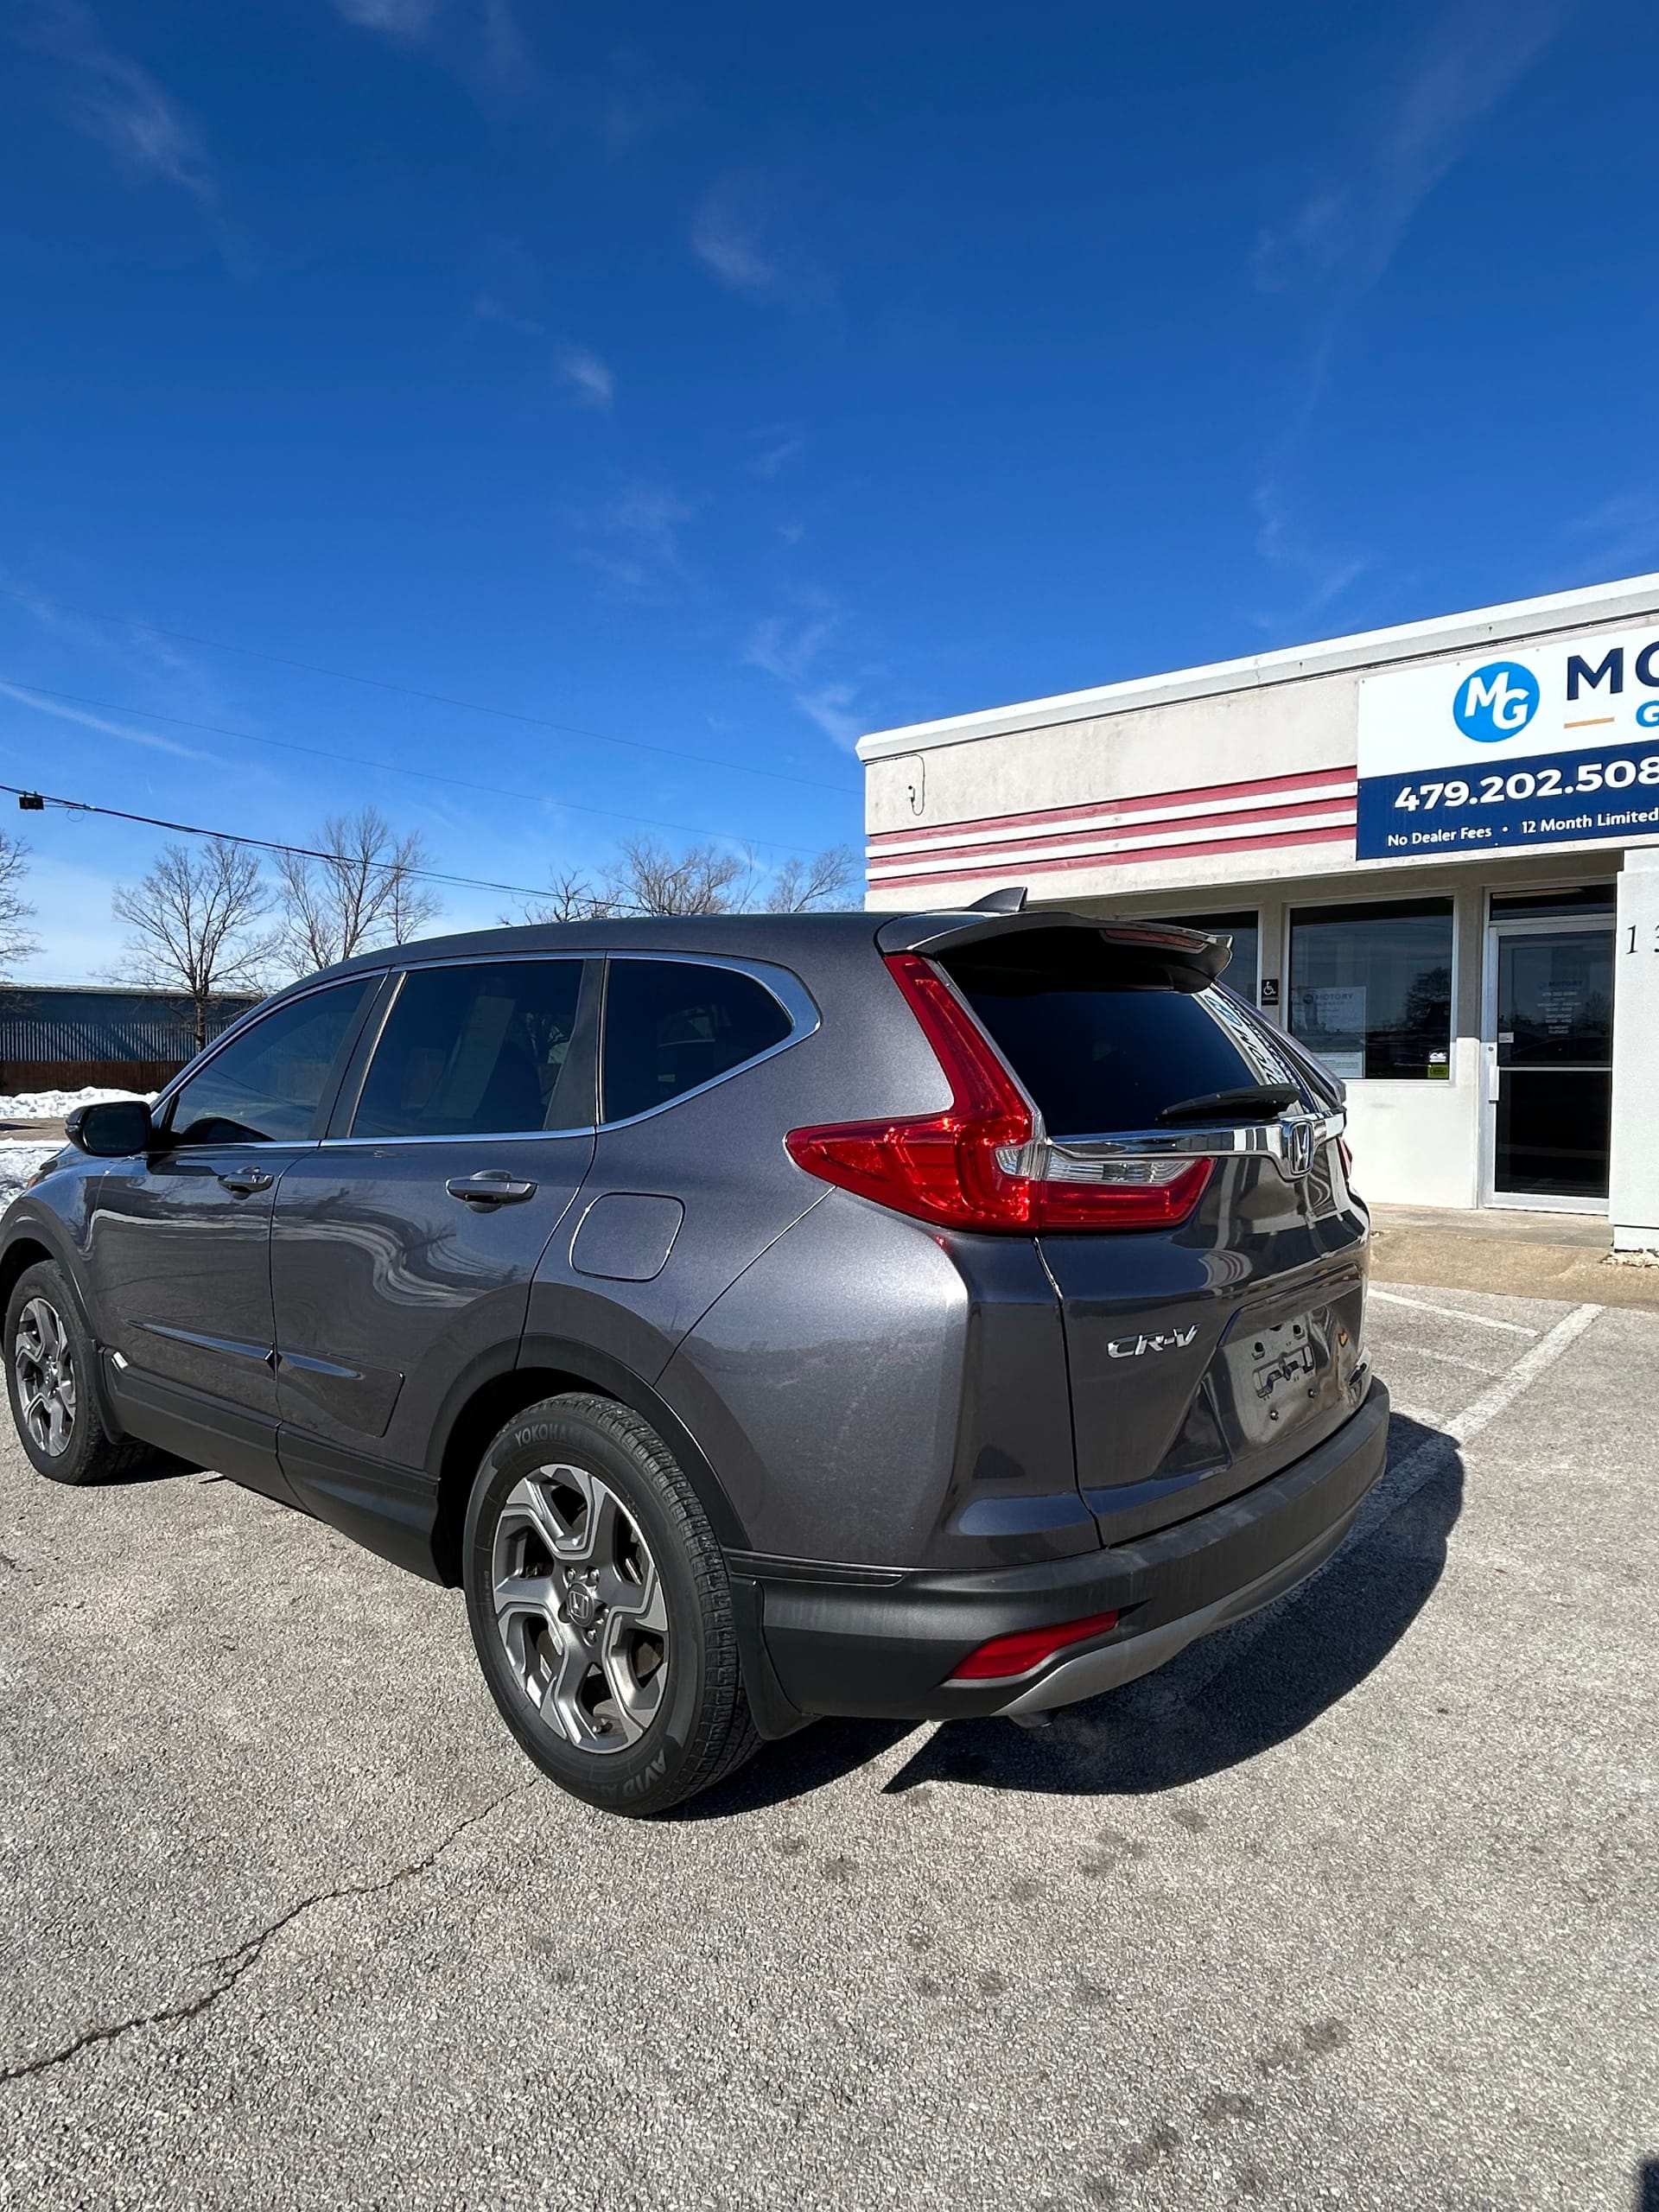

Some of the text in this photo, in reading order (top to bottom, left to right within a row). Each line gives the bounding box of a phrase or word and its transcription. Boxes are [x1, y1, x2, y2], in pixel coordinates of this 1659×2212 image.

[1464, 671, 1529, 730] MG
[1394, 755, 1659, 811] 479.202.508
[1387, 807, 1659, 847] No Dealer Fees 12 Month Limited
[1107, 1322, 1200, 1358] CR-V
